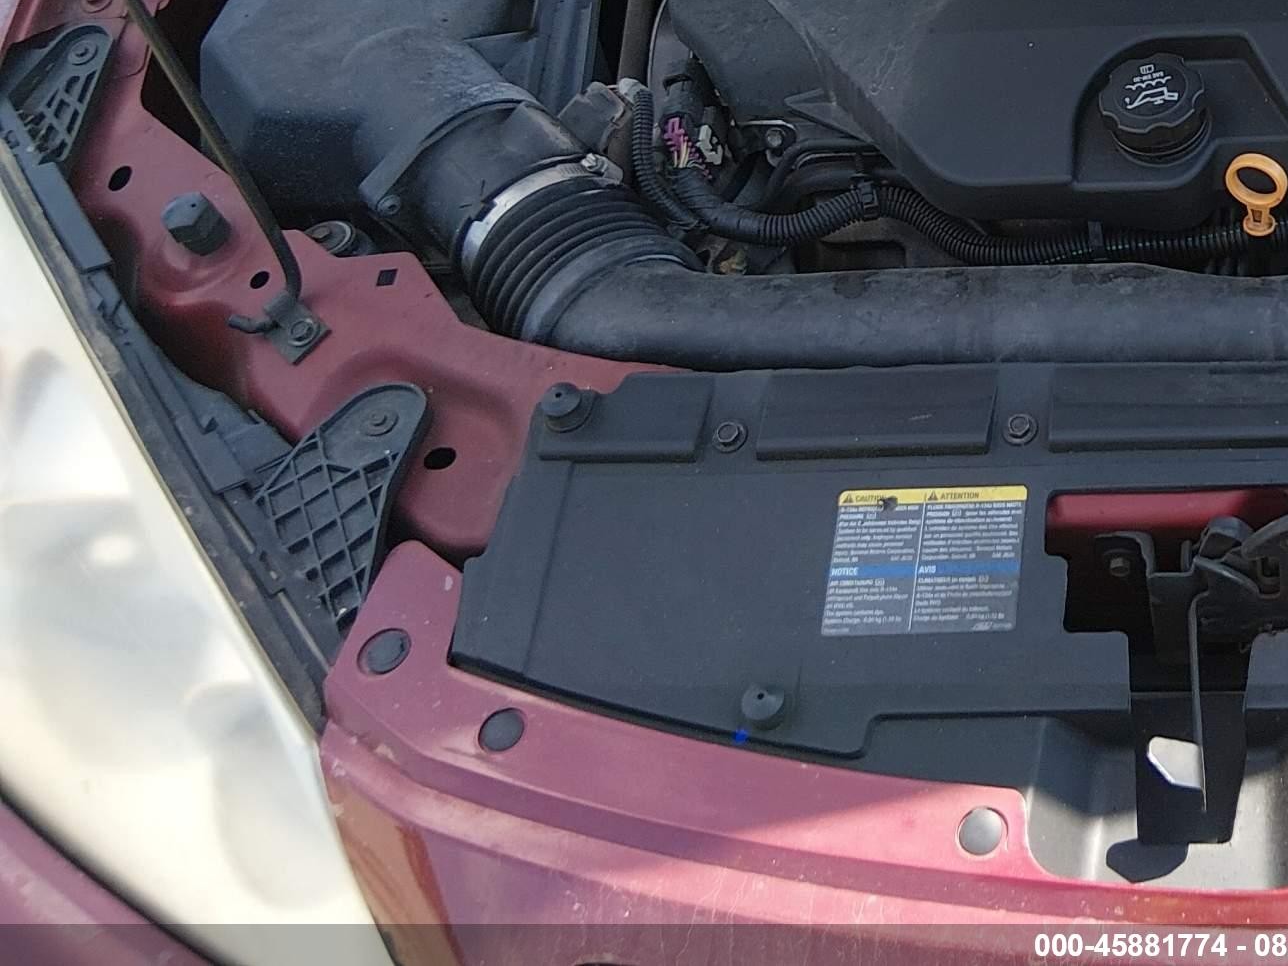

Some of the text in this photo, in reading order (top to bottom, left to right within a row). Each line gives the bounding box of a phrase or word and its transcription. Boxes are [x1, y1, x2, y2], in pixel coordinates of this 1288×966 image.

[940, 492, 979, 500] ATTENTION
[831, 567, 859, 576] NOTICE
[918, 565, 937, 575] AVIS
